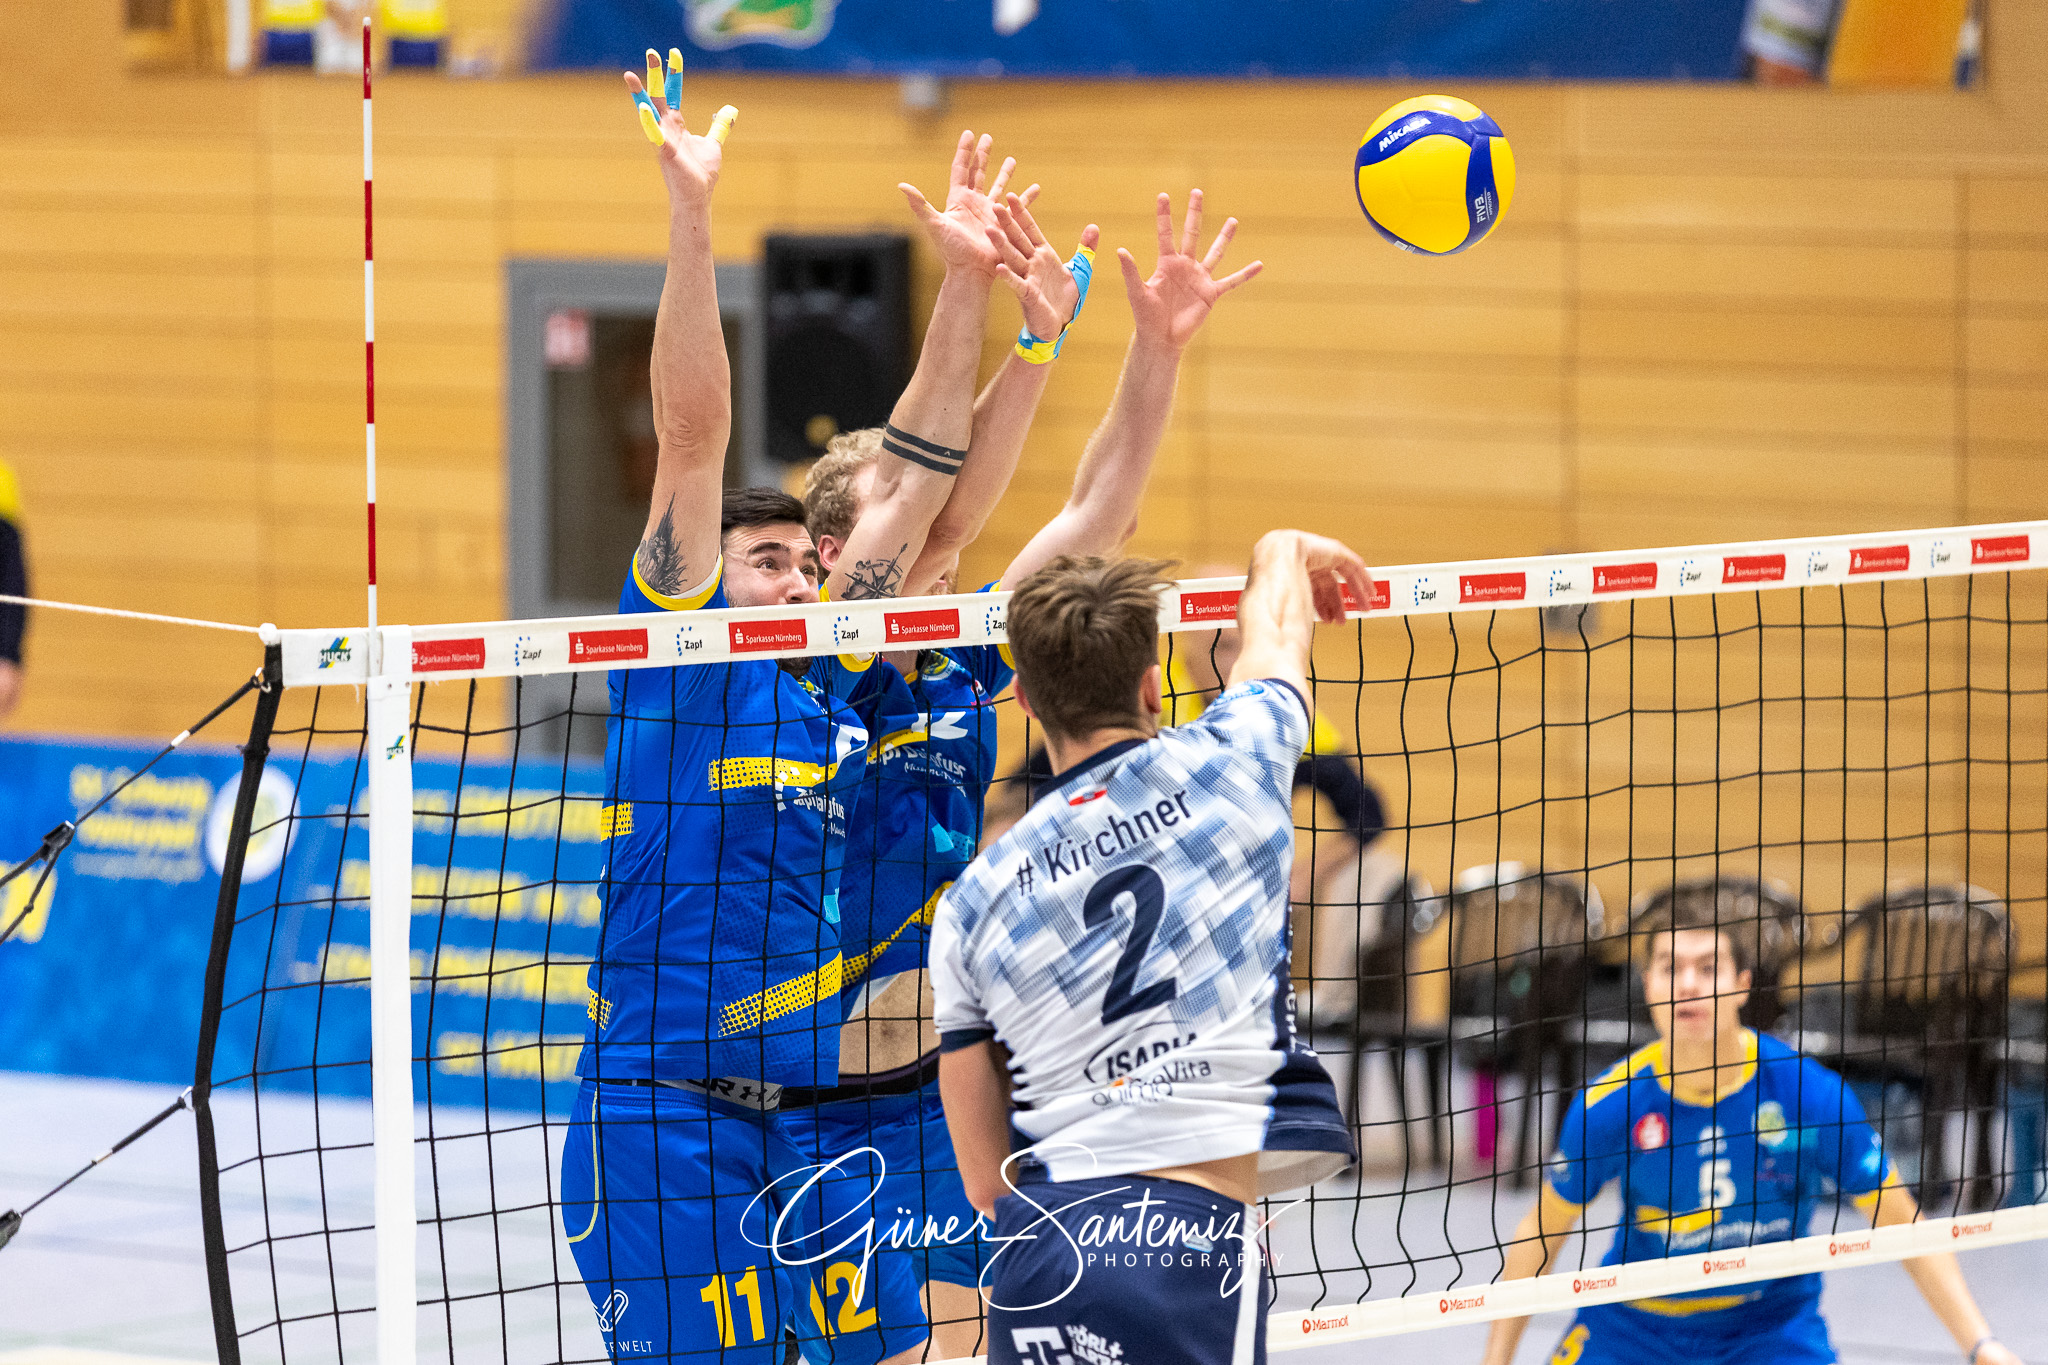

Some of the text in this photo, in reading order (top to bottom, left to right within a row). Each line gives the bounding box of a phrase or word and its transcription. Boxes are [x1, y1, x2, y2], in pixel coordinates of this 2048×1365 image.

[1474, 195, 1487, 224] FIVB
[1606, 576, 1631, 586] Sparkasse
[1685, 571, 1702, 582] Zapf
[1474, 584, 1522, 596] Sparkasse Nürnberg
[1555, 581, 1572, 592] Zapf
[1420, 590, 1437, 601] Zapf
[1195, 602, 1238, 615] Sparkasse Nürnb
[901, 622, 955, 635] Sparkasse Nürnberg
[992, 619, 1007, 630] Zap
[745, 632, 802, 645] Sparkasse Nürnberg
[841, 629, 859, 640] Zapf
[585, 642, 644, 655] Sparkasse Nürnberg
[683, 639, 703, 651] Zapf
[318, 648, 352, 664] HUCK
[419, 652, 481, 666] Sparkasse Nürnberg
[522, 649, 542, 661] Zapf
[1045, 789, 1192, 884] Kirchner
[1082, 862, 1177, 1027] 2
[1698, 1157, 1737, 1208] 5
[1712, 1256, 1746, 1273] Marmot
[1582, 1275, 1617, 1292] Marmot
[700, 1265, 766, 1348] 11
[1449, 1295, 1485, 1312] Marmot
[1312, 1314, 1349, 1332] Marmot
